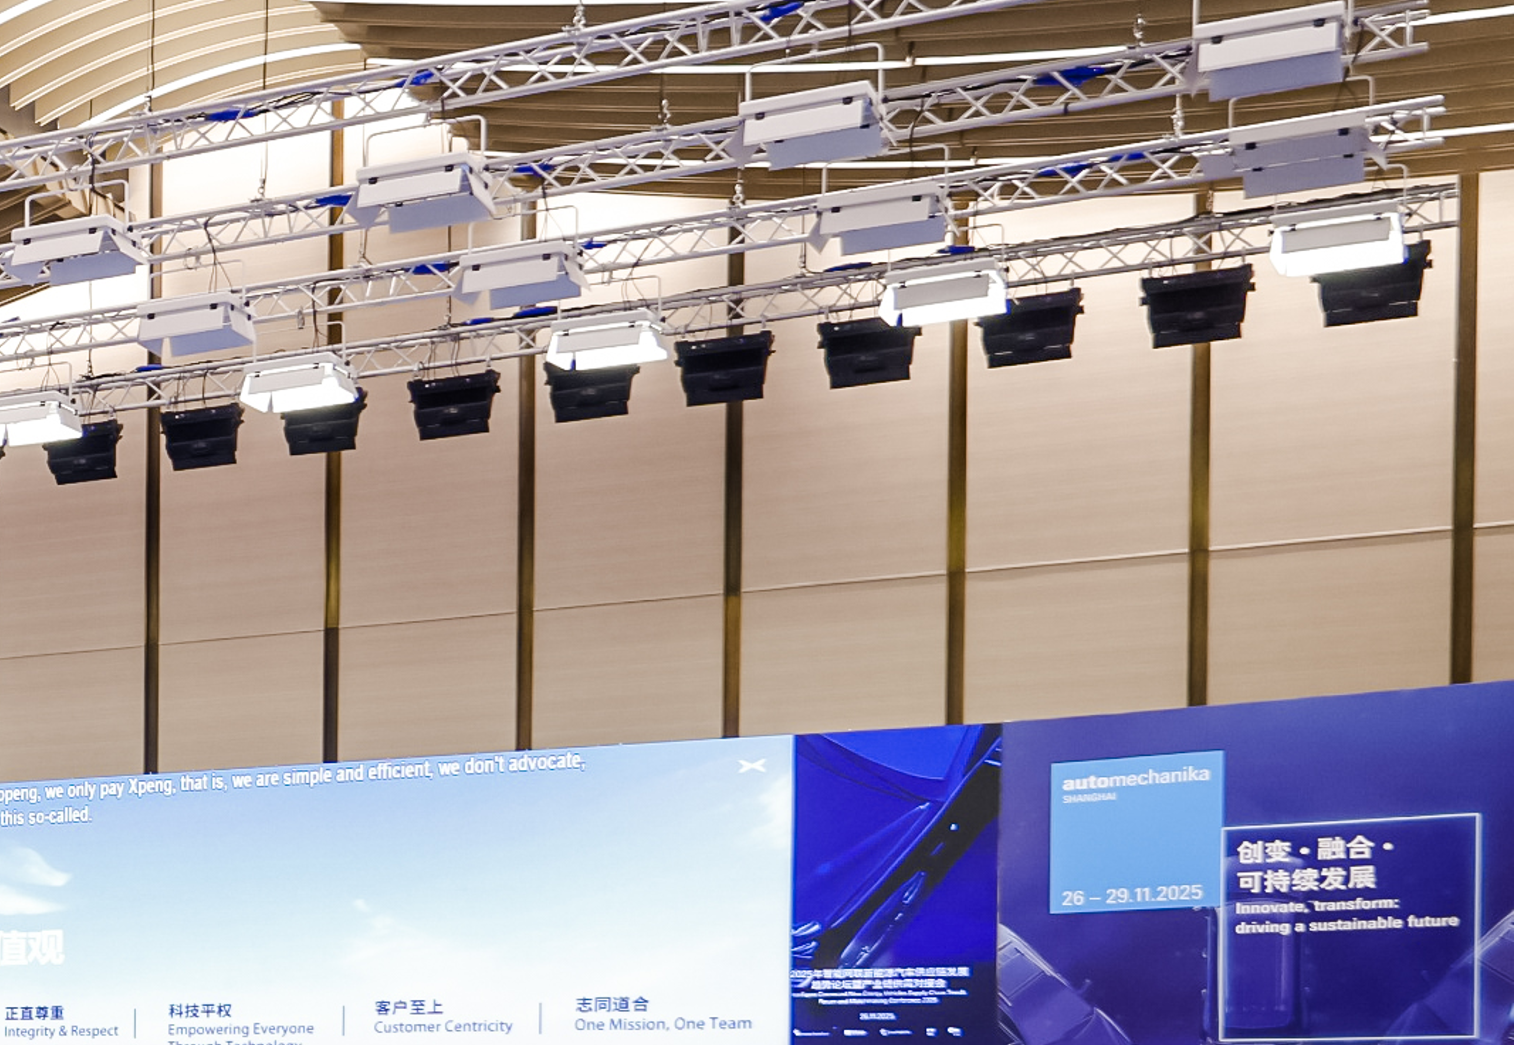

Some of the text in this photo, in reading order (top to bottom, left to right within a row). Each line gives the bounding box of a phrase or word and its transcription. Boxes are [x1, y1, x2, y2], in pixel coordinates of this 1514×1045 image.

[45, 786, 63, 800] we
[67, 781, 95, 801] only
[100, 782, 124, 800] pay
[128, 777, 176, 797] Xpeng,
[180, 774, 208, 791] that
[212, 772, 228, 792] is,
[232, 774, 252, 788] we
[256, 772, 279, 788] are
[283, 767, 332, 788] simple
[336, 765, 364, 783] and
[368, 760, 434, 781] efficient,
[438, 762, 460, 776] we
[465, 756, 505, 775] don't
[508, 751, 586, 773] advocate,
[1062, 765, 1211, 791] automechanika
[1062, 792, 1117, 804] SHANGHAI
[0, 809, 24, 827] this
[28, 805, 93, 826] so-called.
[1237, 865, 1377, 893] 可持续发展
[1062, 890, 1085, 906] 26
[1106, 884, 1203, 904] 29.11.2025
[1235, 898, 1400, 915] Innovate, transform:
[1235, 914, 1460, 935] driving a sustainable future
[4, 1005, 65, 1021] 正直尊重
[168, 1003, 233, 1018] 科技平权
[375, 999, 444, 1016] 客户至上
[575, 996, 649, 1013] 志同道合
[4, 1025, 119, 1040] Integrity & Respect
[168, 1022, 315, 1037] Empowering Everyone
[374, 1019, 513, 1035] Customer Centricity
[574, 1016, 753, 1032] One Mission, One Team
